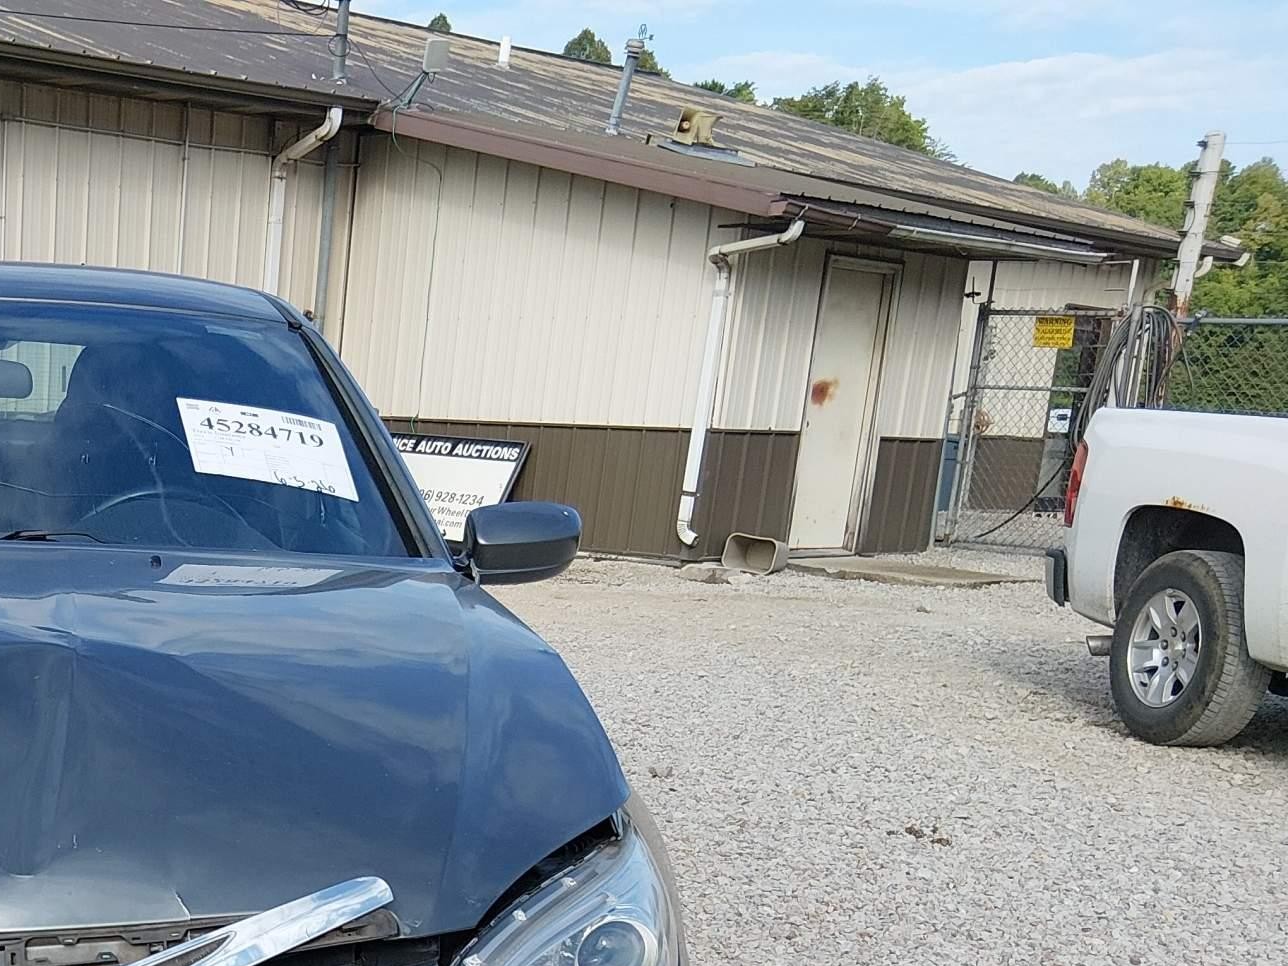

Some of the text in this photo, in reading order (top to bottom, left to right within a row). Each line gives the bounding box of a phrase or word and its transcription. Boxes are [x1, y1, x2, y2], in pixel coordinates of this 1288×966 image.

[200, 416, 324, 448] 45284719
[416, 440, 452, 455] AUTO
[452, 443, 520, 460] AUCTIONS
[435, 491, 485, 506] 928-1234
[437, 506, 465, 517] Wheel
